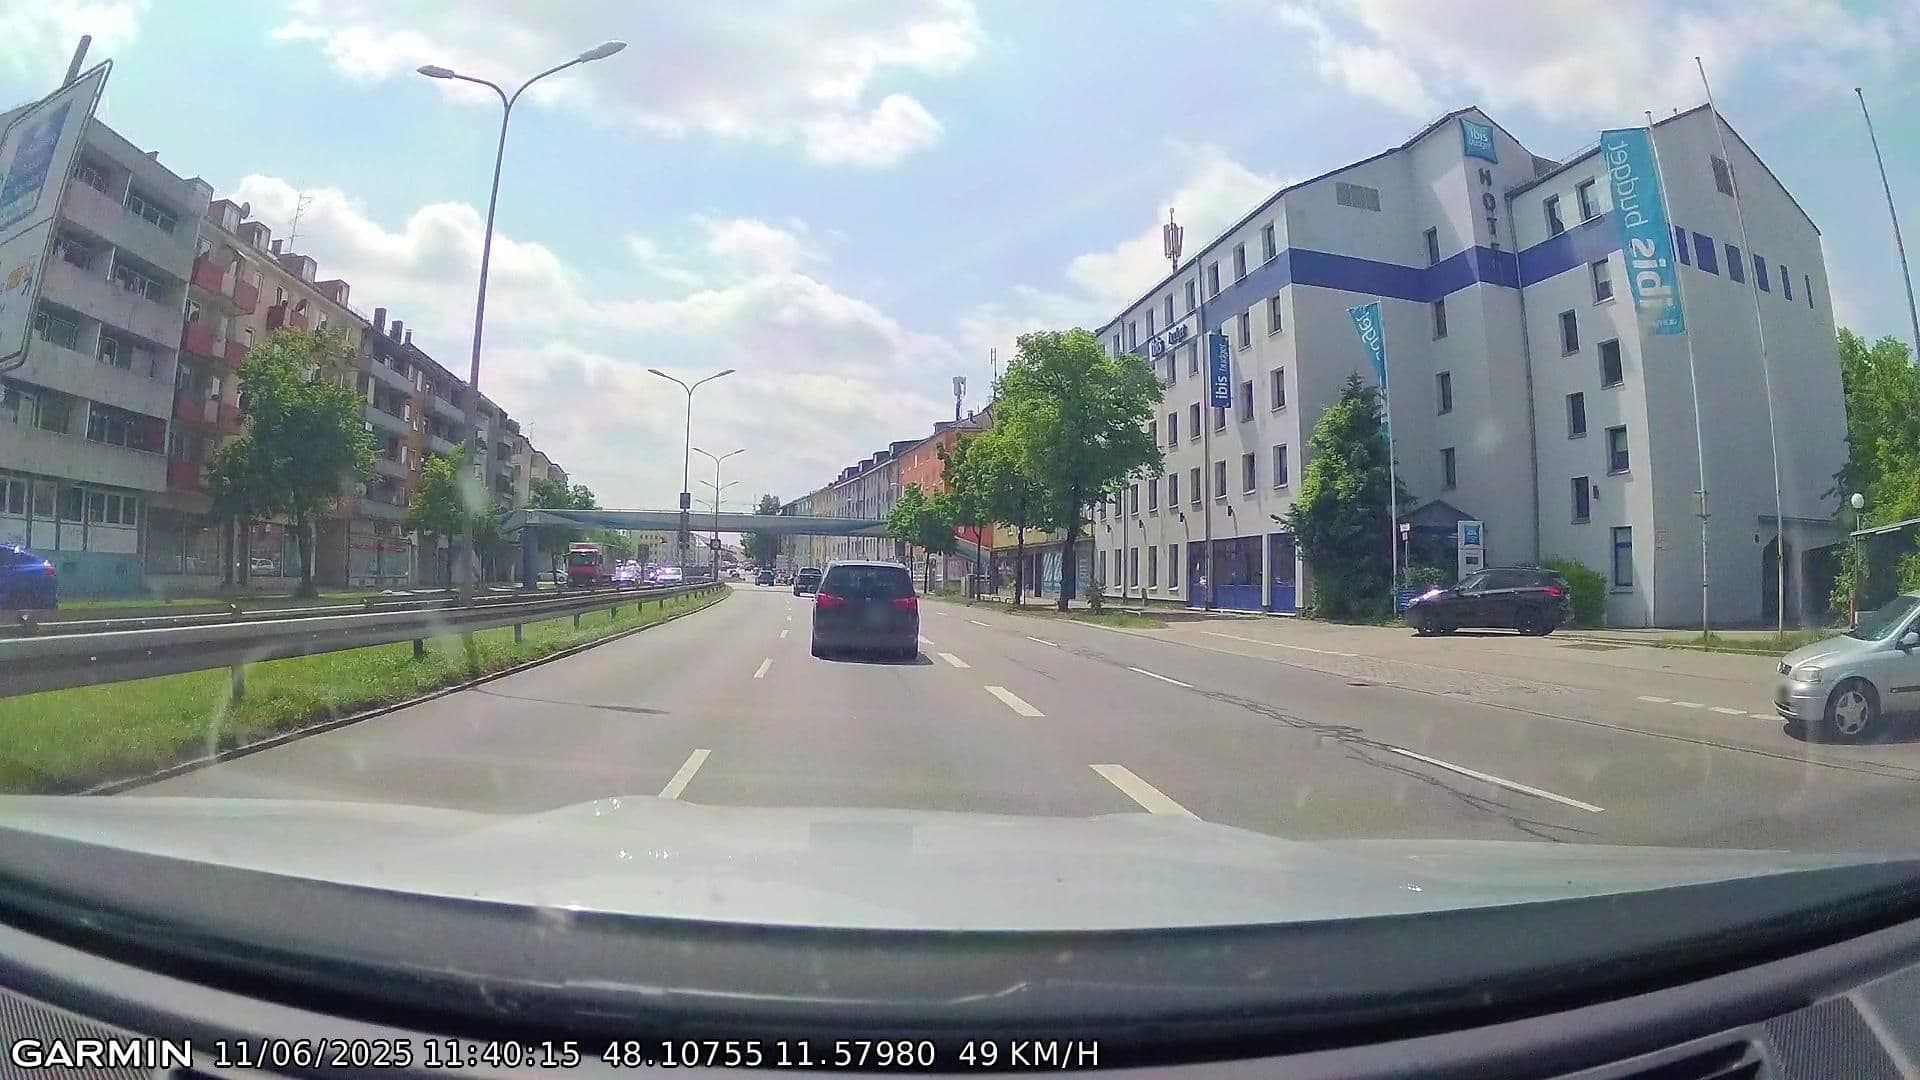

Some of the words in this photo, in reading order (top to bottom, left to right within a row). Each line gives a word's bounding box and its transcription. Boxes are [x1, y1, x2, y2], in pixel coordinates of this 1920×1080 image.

[1470, 128, 1488, 142] ibis
[1478, 167, 1502, 256] HOT
[1215, 375, 1229, 399] ibis
